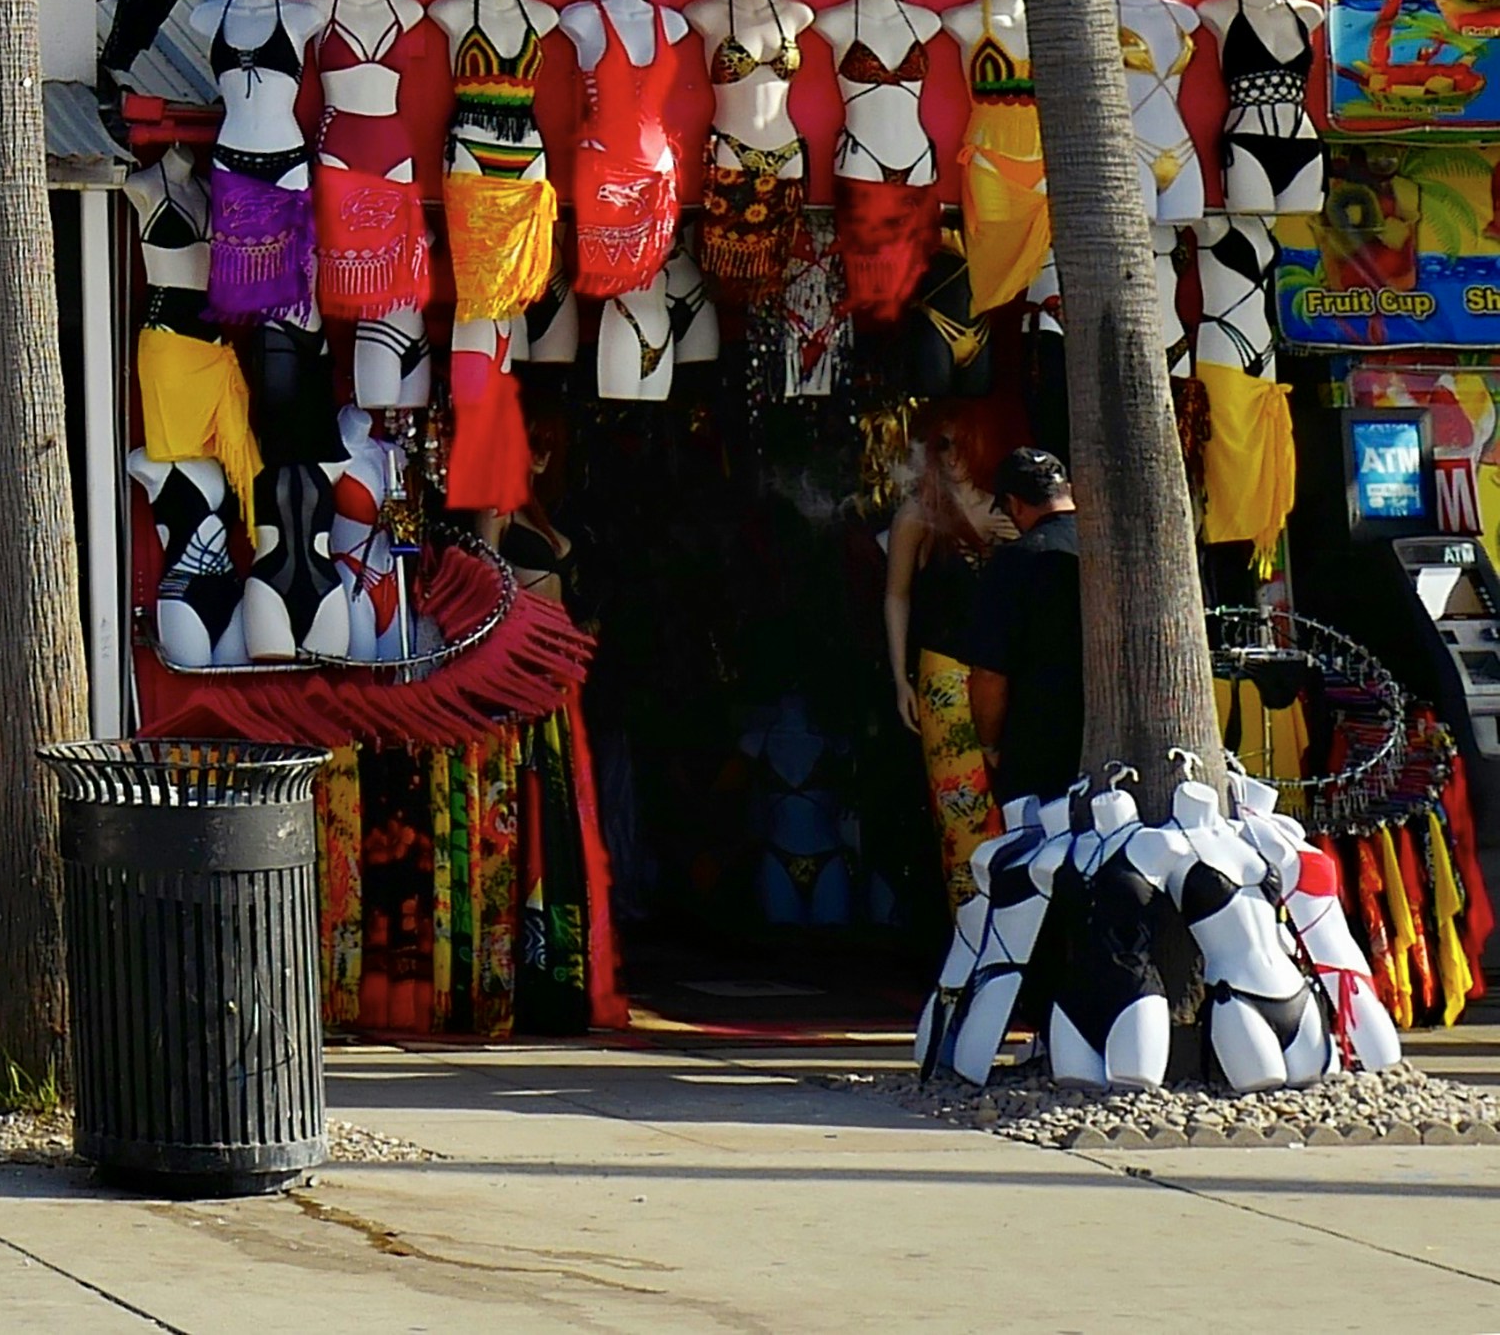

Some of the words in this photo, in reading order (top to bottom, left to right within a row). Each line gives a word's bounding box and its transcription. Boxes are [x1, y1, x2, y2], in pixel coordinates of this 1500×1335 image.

[1306, 290, 1374, 316] Fruit
[1378, 287, 1435, 320] Cup
[1360, 446, 1420, 474] ATM
[1443, 542, 1476, 564] ATM
